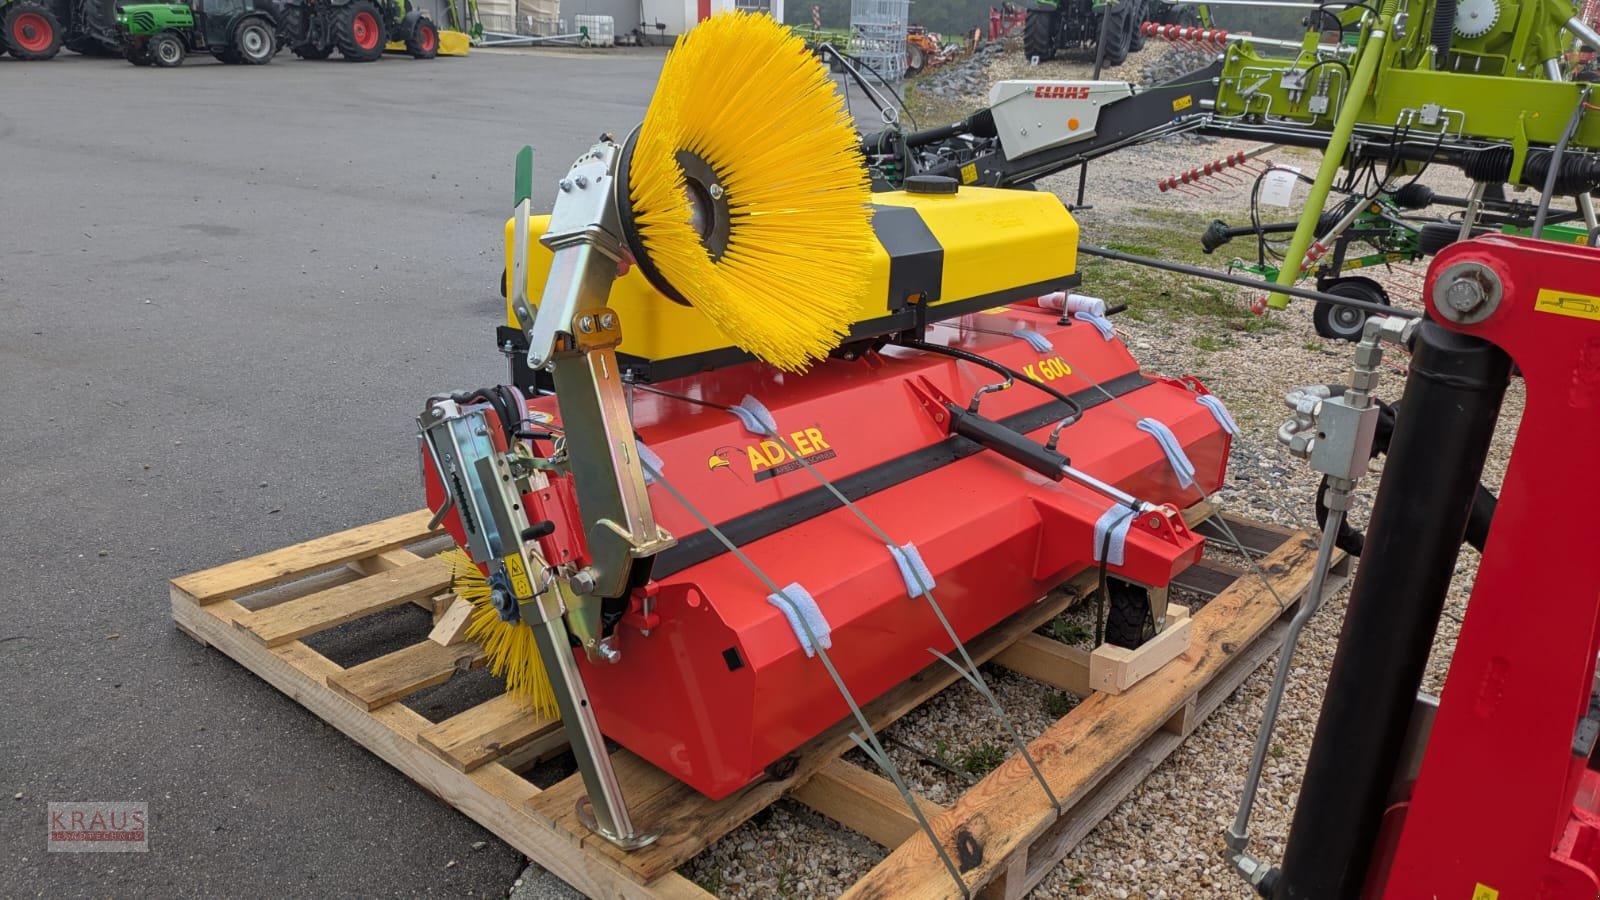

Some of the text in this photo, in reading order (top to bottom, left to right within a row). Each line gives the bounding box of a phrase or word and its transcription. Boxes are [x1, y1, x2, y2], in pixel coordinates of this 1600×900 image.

[1035, 86, 1090, 99] CLAAS
[1022, 357, 1072, 383] K 600
[747, 427, 831, 471] ADLER
